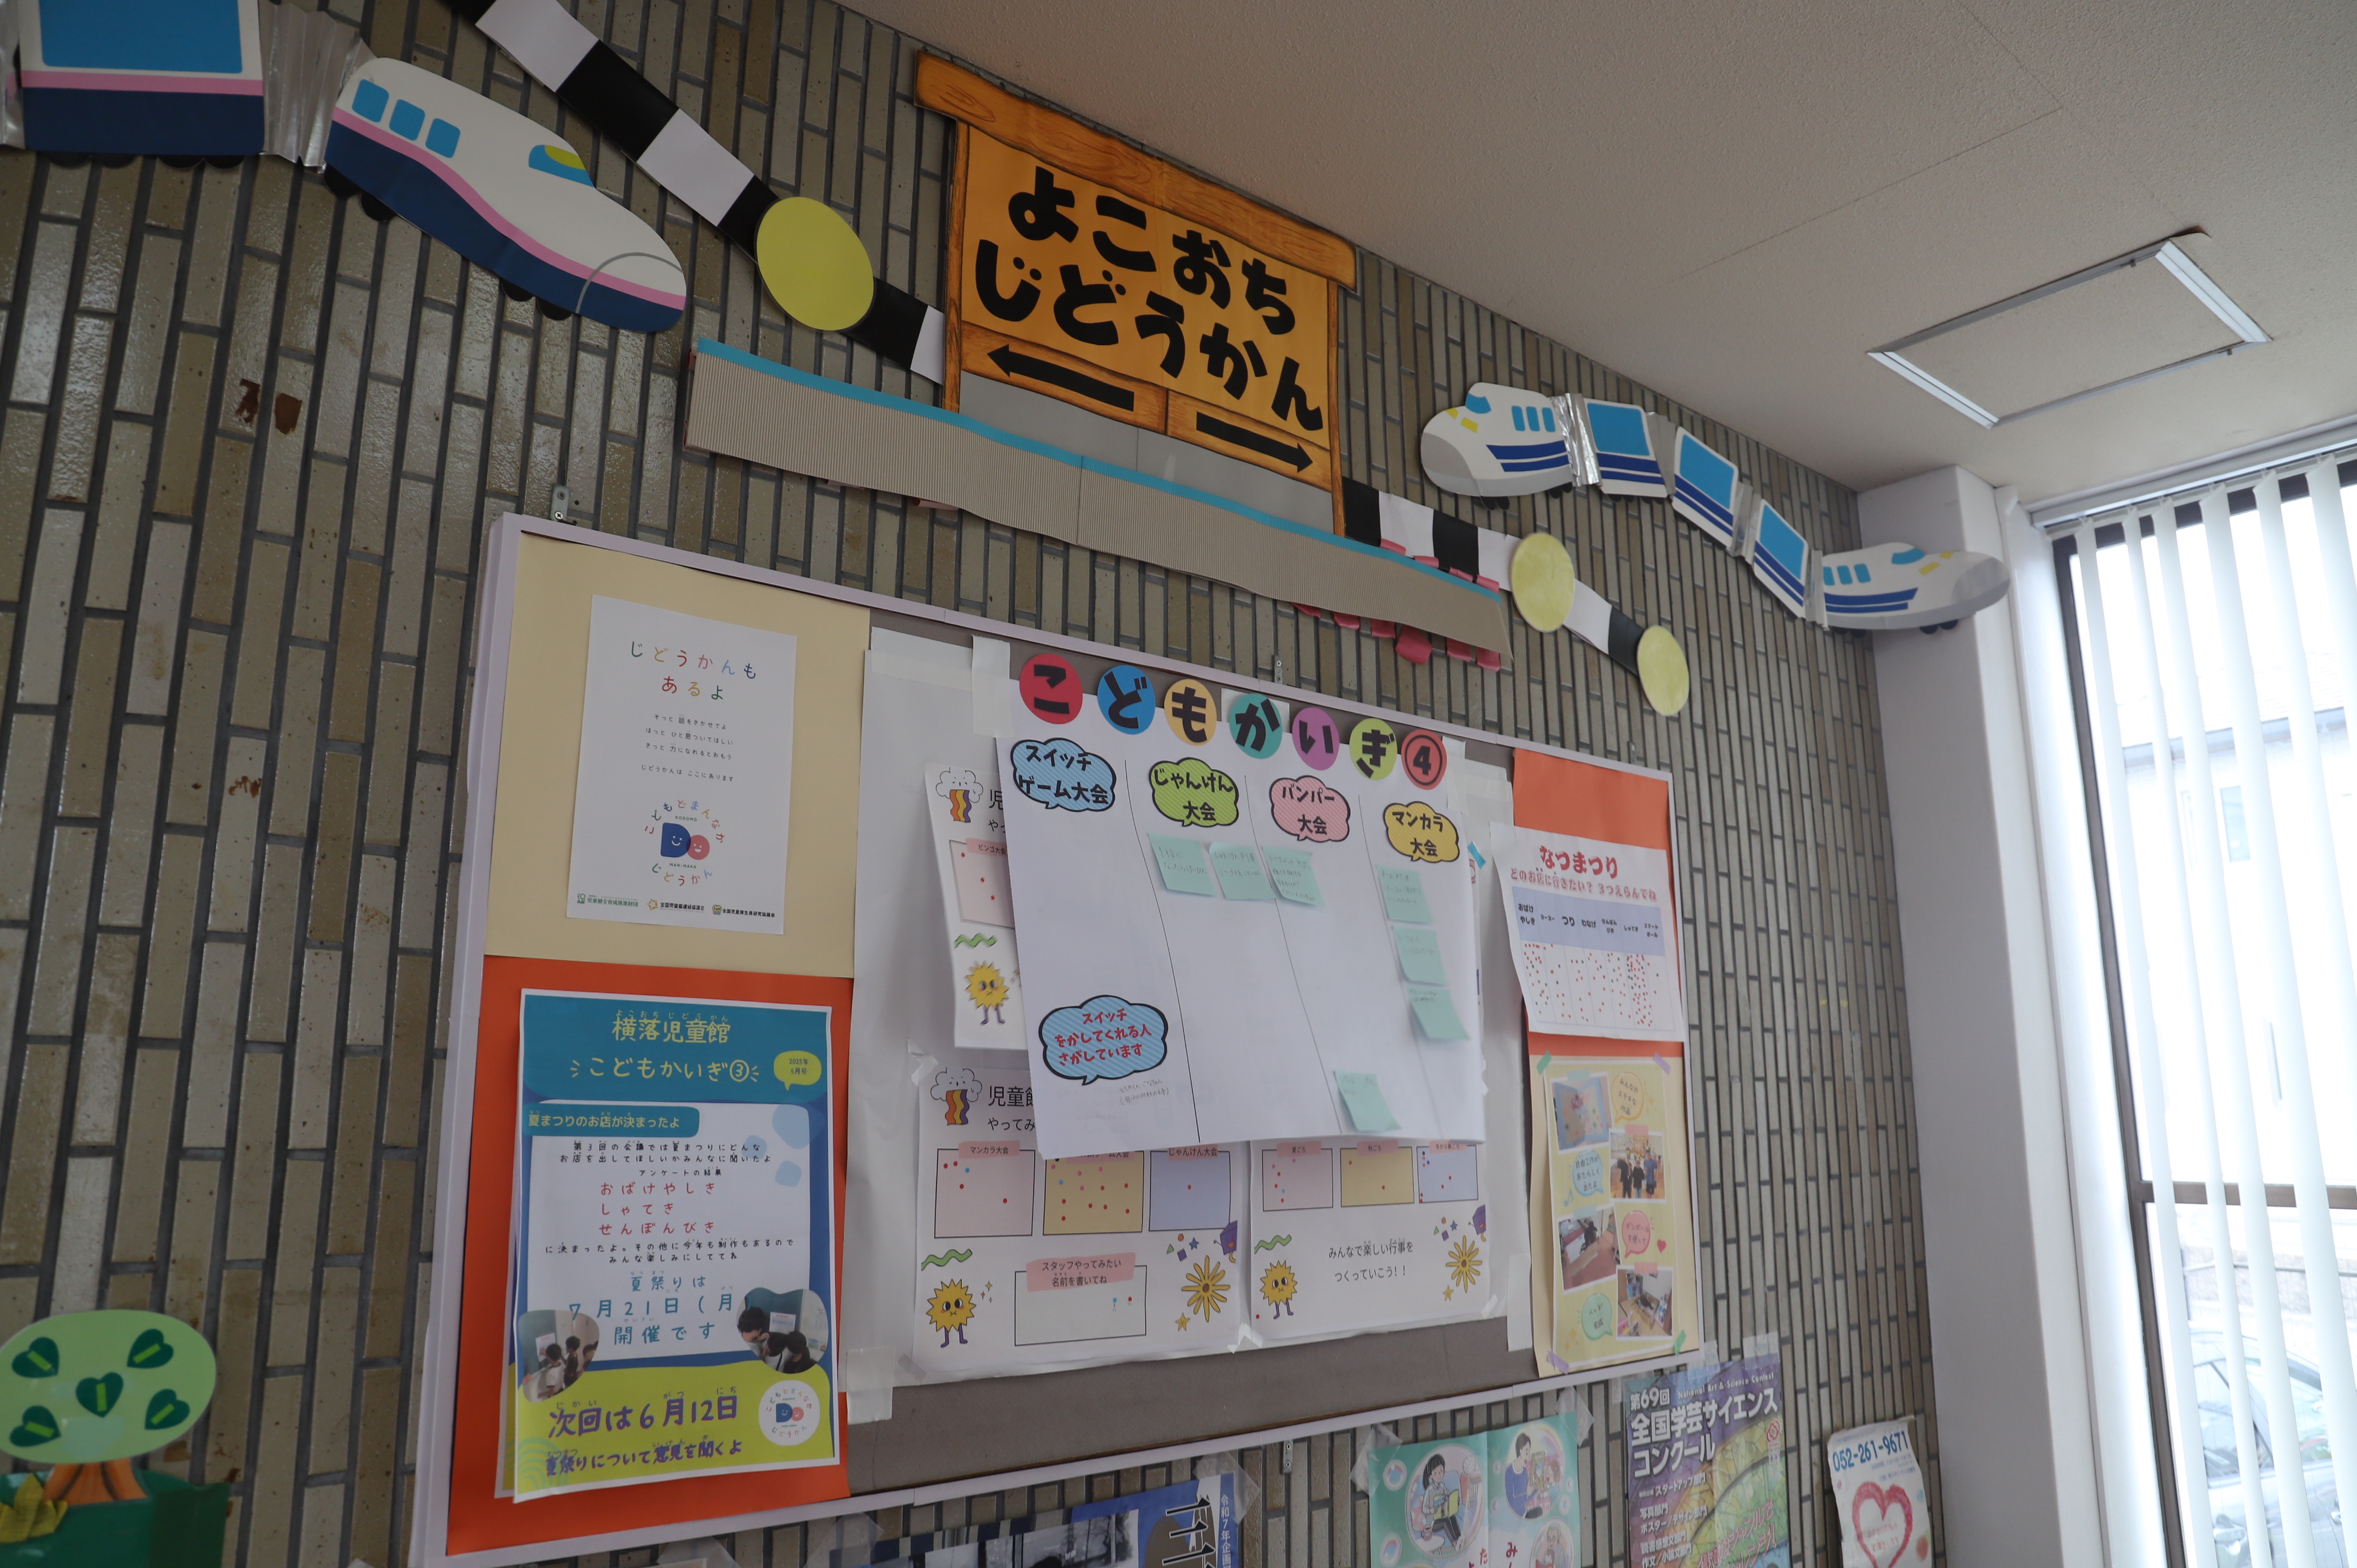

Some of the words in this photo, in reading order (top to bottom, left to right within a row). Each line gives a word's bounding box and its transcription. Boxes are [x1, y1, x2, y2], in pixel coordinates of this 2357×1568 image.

[1008, 166, 1295, 335] よこおち
[975, 239, 1324, 432] じどうかん
[631, 641, 756, 679] じどうかんも
[662, 676, 724, 700] あるよ
[679, 716, 726, 730] 話をきかせてよ
[671, 732, 733, 745] ひと息ついてほしい
[670, 745, 732, 760] 力になれるとおもう
[1025, 744, 1092, 772] スイッチ
[641, 764, 682, 774] じどうかんは
[688, 770, 733, 782] ここにあります
[1154, 768, 1234, 794] じゃんけん
[1018, 774, 1110, 805] ゲーム大会
[1282, 783, 1335, 803] バンパー
[1183, 801, 1217, 822] 大会
[645, 799, 725, 843] こどもまんなか
[1297, 814, 1328, 836] 大会
[1392, 810, 1444, 833] マンカラ
[978, 843, 1006, 855] ビンゴ大会
[1410, 837, 1439, 858] 大会
[1539, 845, 1618, 879] なつまつり
[652, 863, 713, 886] じどうかん
[1511, 868, 1593, 893] どのお店に行きたい?
[1518, 902, 1534, 913] おばけ
[1520, 916, 1535, 926] やしき
[1562, 915, 1575, 927] つり
[616, 1009, 659, 1019] よこおち
[1082, 1008, 1127, 1025] スイッチ
[612, 1017, 731, 1043] 横落児童館
[1054, 1023, 1152, 1047] をかしてくれる人
[1058, 1042, 1142, 1066] さがしています
[790, 1067, 807, 1075] 5月号
[1620, 1078, 1639, 1094] みんなの
[1619, 1090, 1637, 1106] ステキな
[1620, 1104, 1631, 1116] 作品
[529, 1114, 679, 1128] 夏まつりのお店が決まったよ
[988, 1118, 1036, 1131] やってみ
[573, 1142, 760, 1152] 第3回の会議では夏まつりにどんな
[969, 1146, 1009, 1155] マンカラ大会
[1168, 1147, 1218, 1157] じゃんけん大会
[560, 1153, 771, 1164] お店を出してほしいかみんなに聞いたよ
[639, 1168, 722, 1177] アンケートの結果
[1577, 1168, 1599, 1181] あたらしく
[600, 1182, 714, 1196] おばけやしき
[600, 1203, 674, 1216] しゃてき
[599, 1221, 714, 1235] せんぼんびき
[609, 1252, 738, 1263] みんな楽しみにしててね
[1329, 1241, 1414, 1259] みんなで楽しい行事を
[1042, 1258, 1121, 1271] スタッフやってみたい
[631, 1276, 706, 1292] 夏祭りは
[1052, 1274, 1107, 1287] 名前を書いてね
[614, 1322, 715, 1345] 開催です
[1678, 1386, 1705, 1399] National
[1707, 1382, 1717, 1392] Art
[1718, 1381, 1725, 1390] &
[1726, 1377, 1749, 1389] Science
[1751, 1372, 1775, 1384] Contest
[556, 1400, 597, 1409] じかい
[663, 1390, 684, 1399] がつ
[716, 1386, 737, 1395] にち
[1630, 1386, 1671, 1412] 第69回
[548, 1395, 738, 1438] 次回は6月12日
[1631, 1387, 1779, 1447] 全国学芸サイエンス
[546, 1439, 742, 1477] 夏祭りについて意見を聞くよ
[1633, 1434, 1717, 1478] コンクール
[1832, 1431, 1909, 1472] 052-261-9671
[1655, 1472, 1707, 1497] スタートアップ部門
[1640, 1502, 1669, 1520] 写真部門
[1220, 1494, 1232, 1568] 令和7年企画
